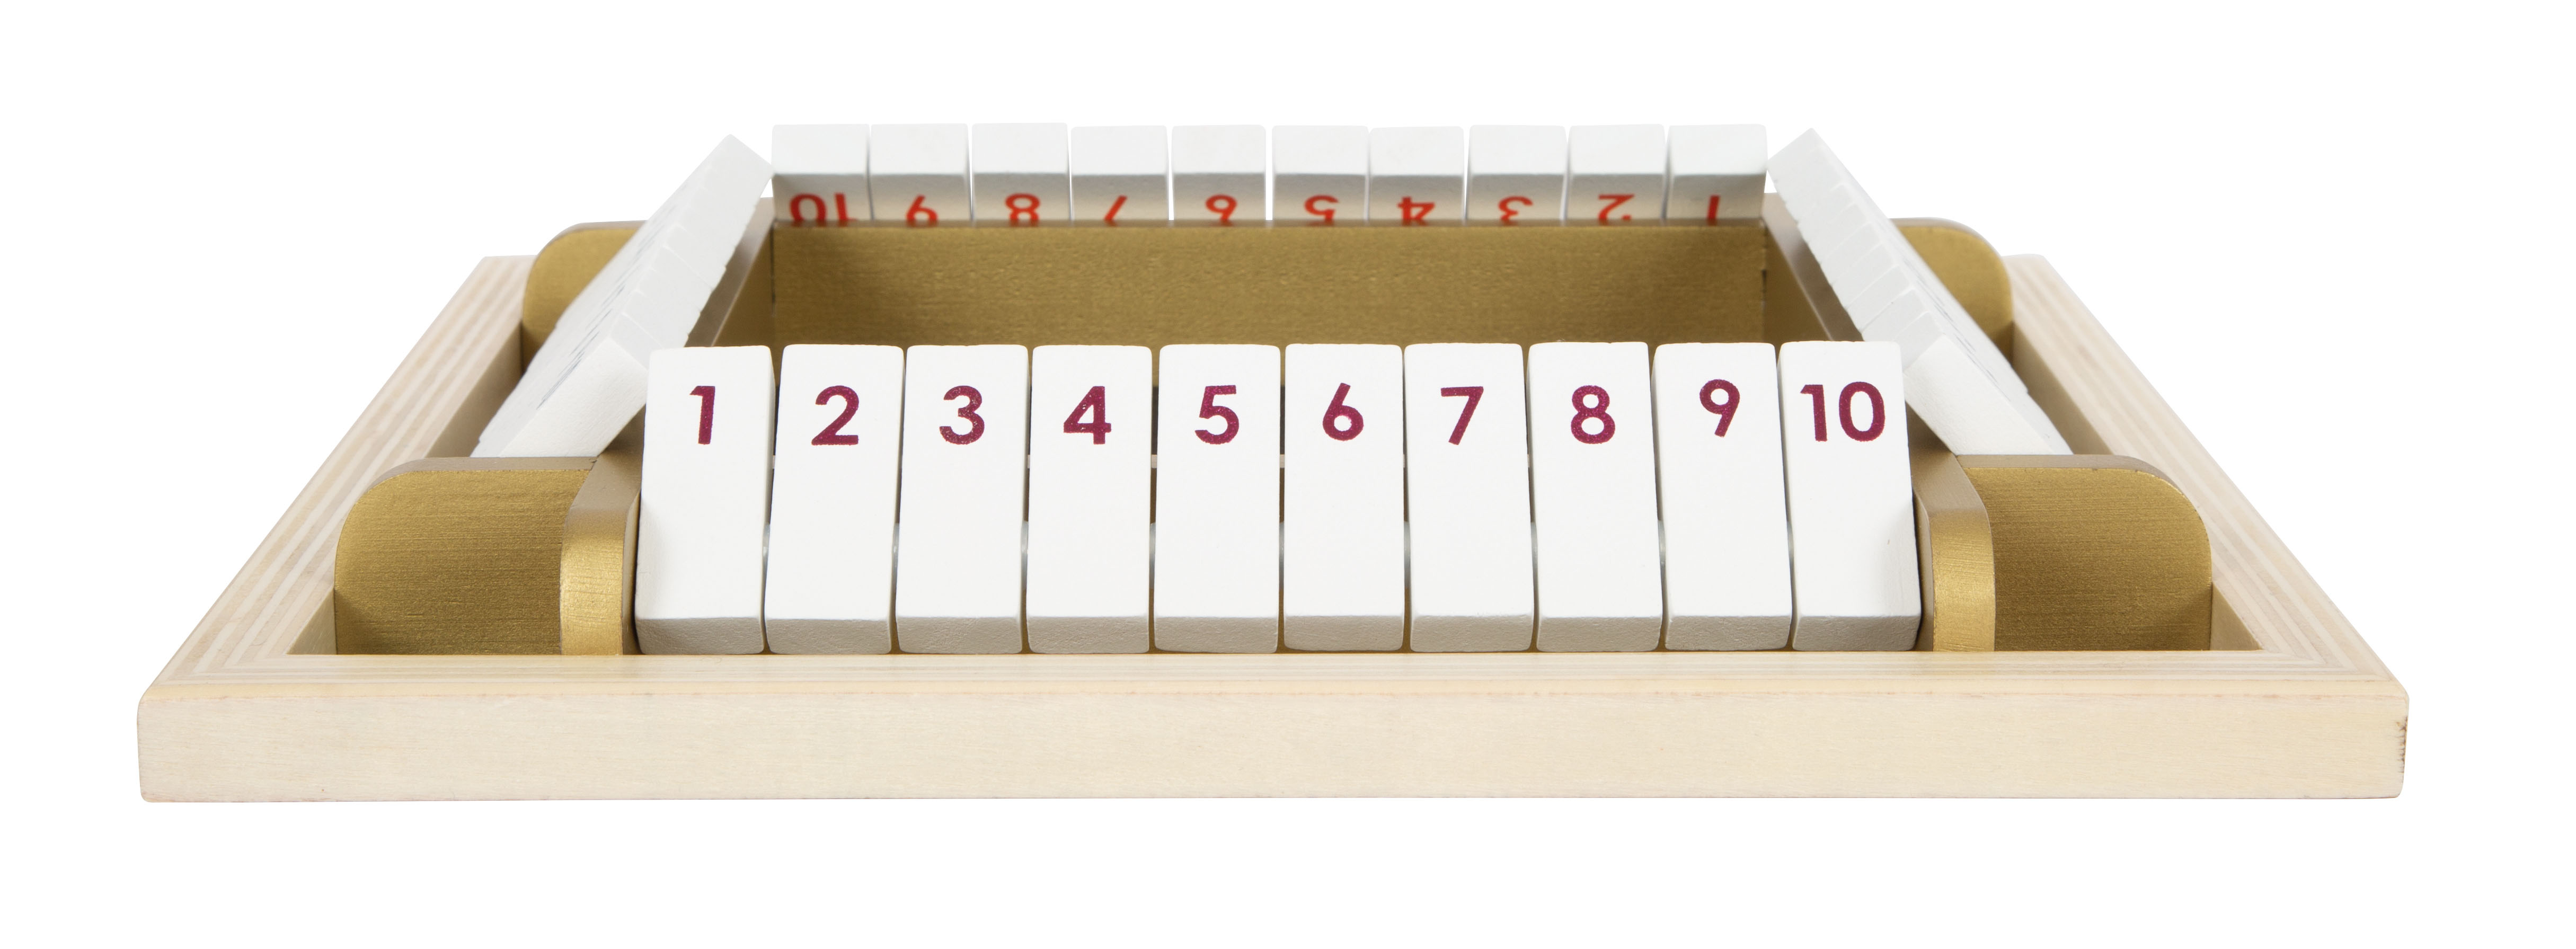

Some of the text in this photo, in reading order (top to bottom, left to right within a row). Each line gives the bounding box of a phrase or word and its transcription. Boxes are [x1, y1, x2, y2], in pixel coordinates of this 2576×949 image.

[790, 192, 857, 223] 10
[1005, 193, 1040, 223] 8
[1304, 195, 1339, 223] 5
[1397, 197, 1435, 223] 4
[1498, 196, 1533, 223] 3
[1598, 194, 1635, 223] 2
[690, 386, 715, 445] 1
[811, 386, 859, 446] 2
[939, 386, 985, 445] 3
[1063, 387, 1112, 445] 4
[1195, 386, 1239, 445] 5
[1322, 384, 1364, 441] 6
[1440, 387, 1484, 446] 7
[1570, 386, 1616, 445] 8
[1699, 380, 1740, 437] 9
[1800, 382, 1885, 442] 10
